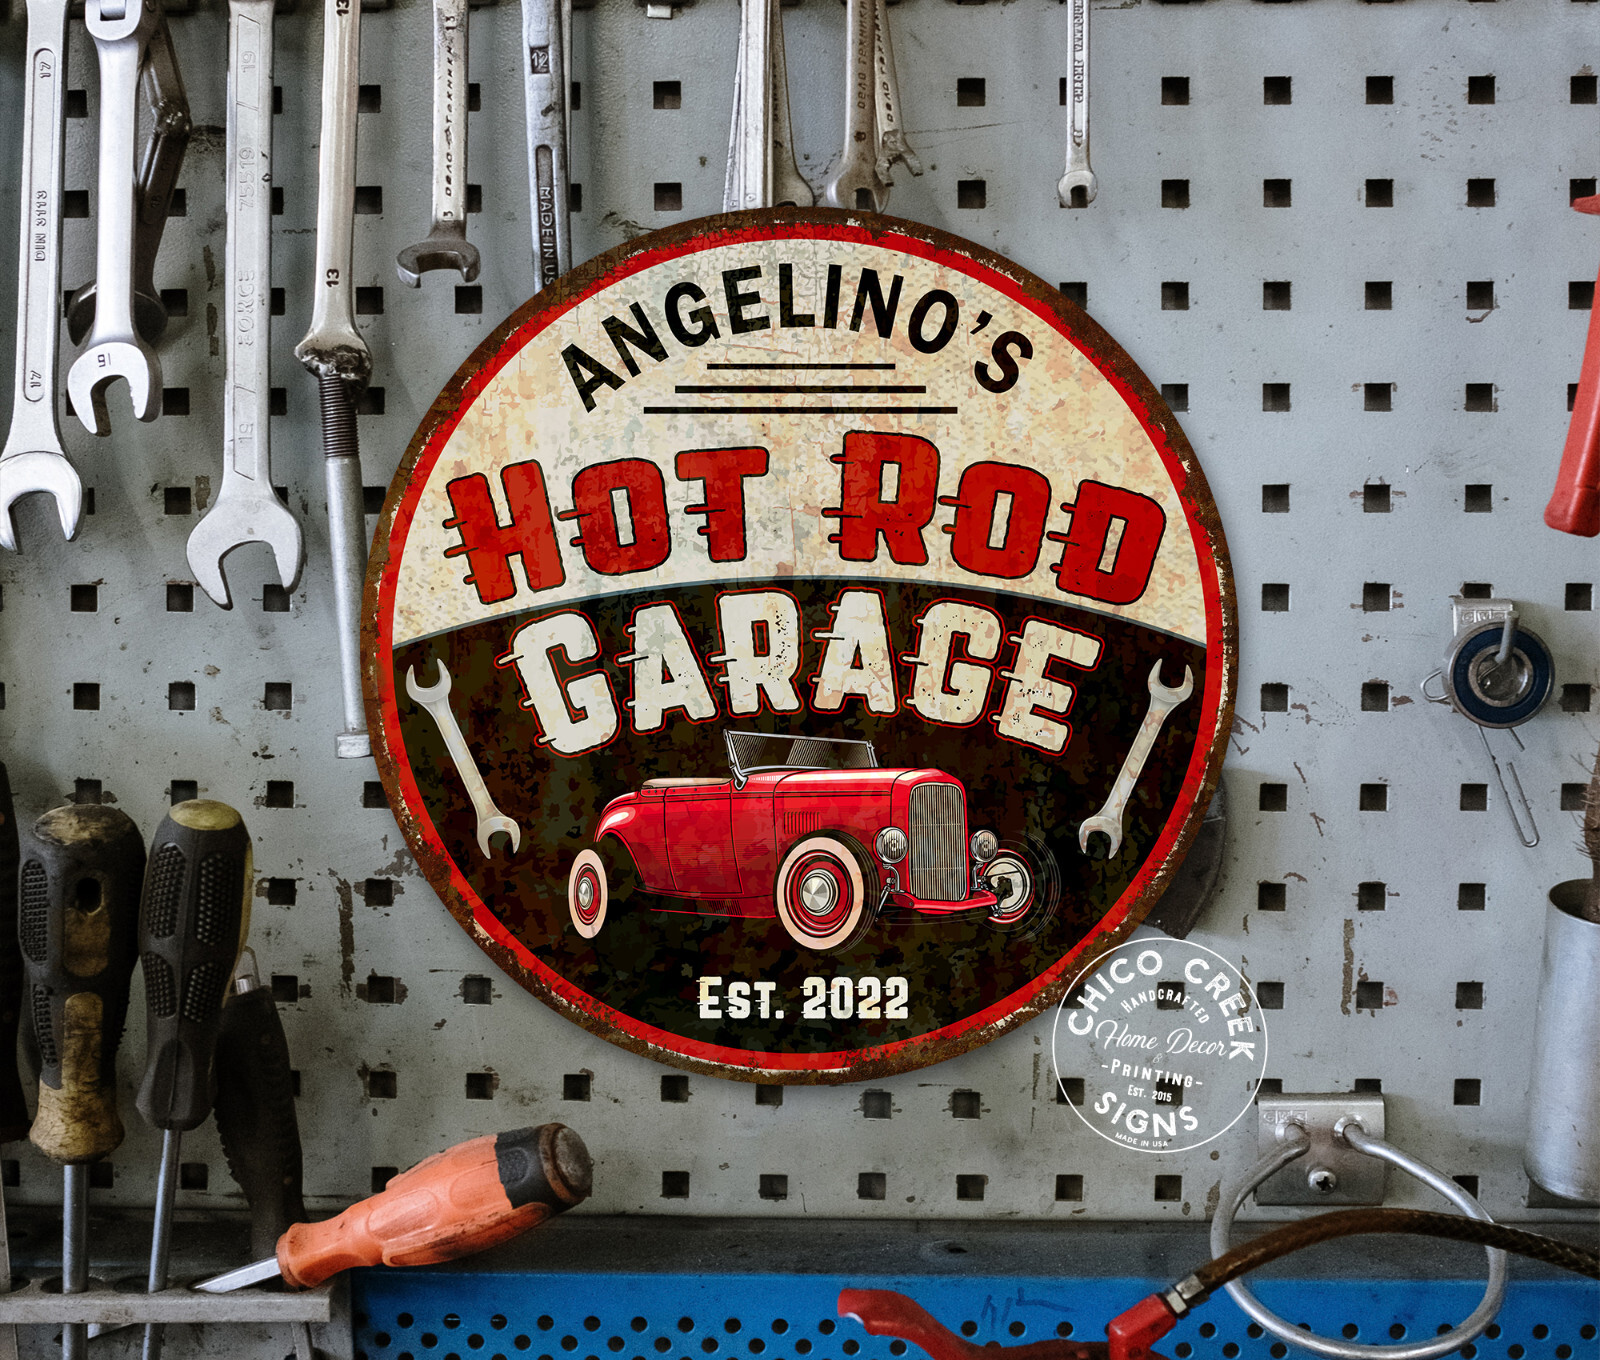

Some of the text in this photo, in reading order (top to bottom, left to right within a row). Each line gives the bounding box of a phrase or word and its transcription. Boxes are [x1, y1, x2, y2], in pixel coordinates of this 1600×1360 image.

[531, 51, 549, 68] 12
[34, 233, 47, 262] DIN
[538, 186, 556, 284] MADE IN US
[237, 269, 255, 347] FORCE
[326, 268, 340, 288] 13
[561, 263, 1034, 413] ANGELINO'S
[30, 369, 41, 388] 17
[443, 430, 1167, 605] HOT ROD
[495, 587, 1104, 757] GARAGE
[696, 976, 908, 1019] EST. 2022
